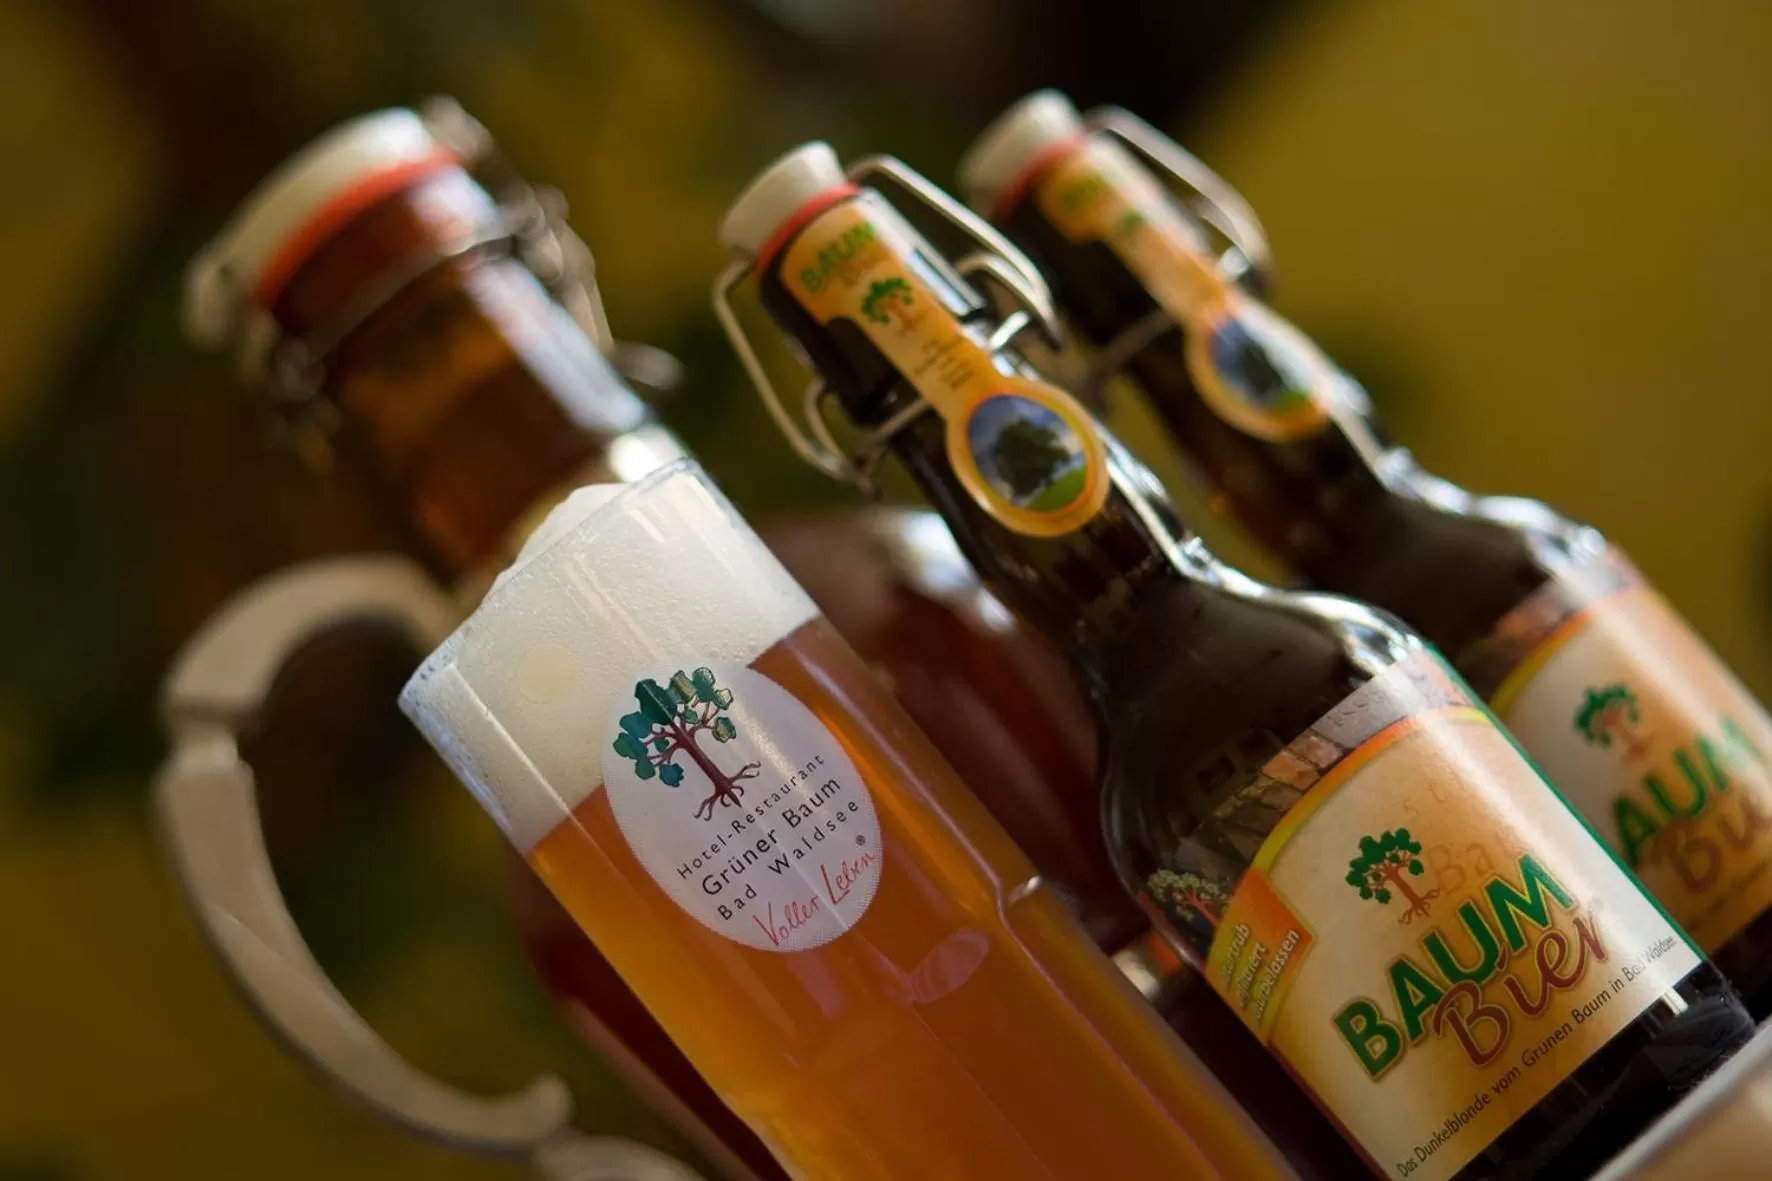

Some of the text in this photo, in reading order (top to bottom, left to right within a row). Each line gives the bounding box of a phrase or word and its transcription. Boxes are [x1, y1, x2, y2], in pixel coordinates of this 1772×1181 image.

[799, 221, 877, 295] BAUM
[677, 754, 825, 880] Hotel-Restaurant
[701, 778, 841, 897] Grüner Baum
[1611, 716, 1765, 868] AUM
[717, 800, 859, 921] Bad Waldsee
[752, 850, 875, 947] Voller Leben
[1333, 853, 1577, 1082] BAUM
[1432, 905, 1609, 1069] Bier
[1396, 1157, 1418, 1178] Das
[1413, 1093, 1491, 1163] Dunkelblonde
[1491, 1066, 1521, 1095] vom
[1571, 989, 1612, 1025] Baum
[1611, 977, 1626, 995] in
